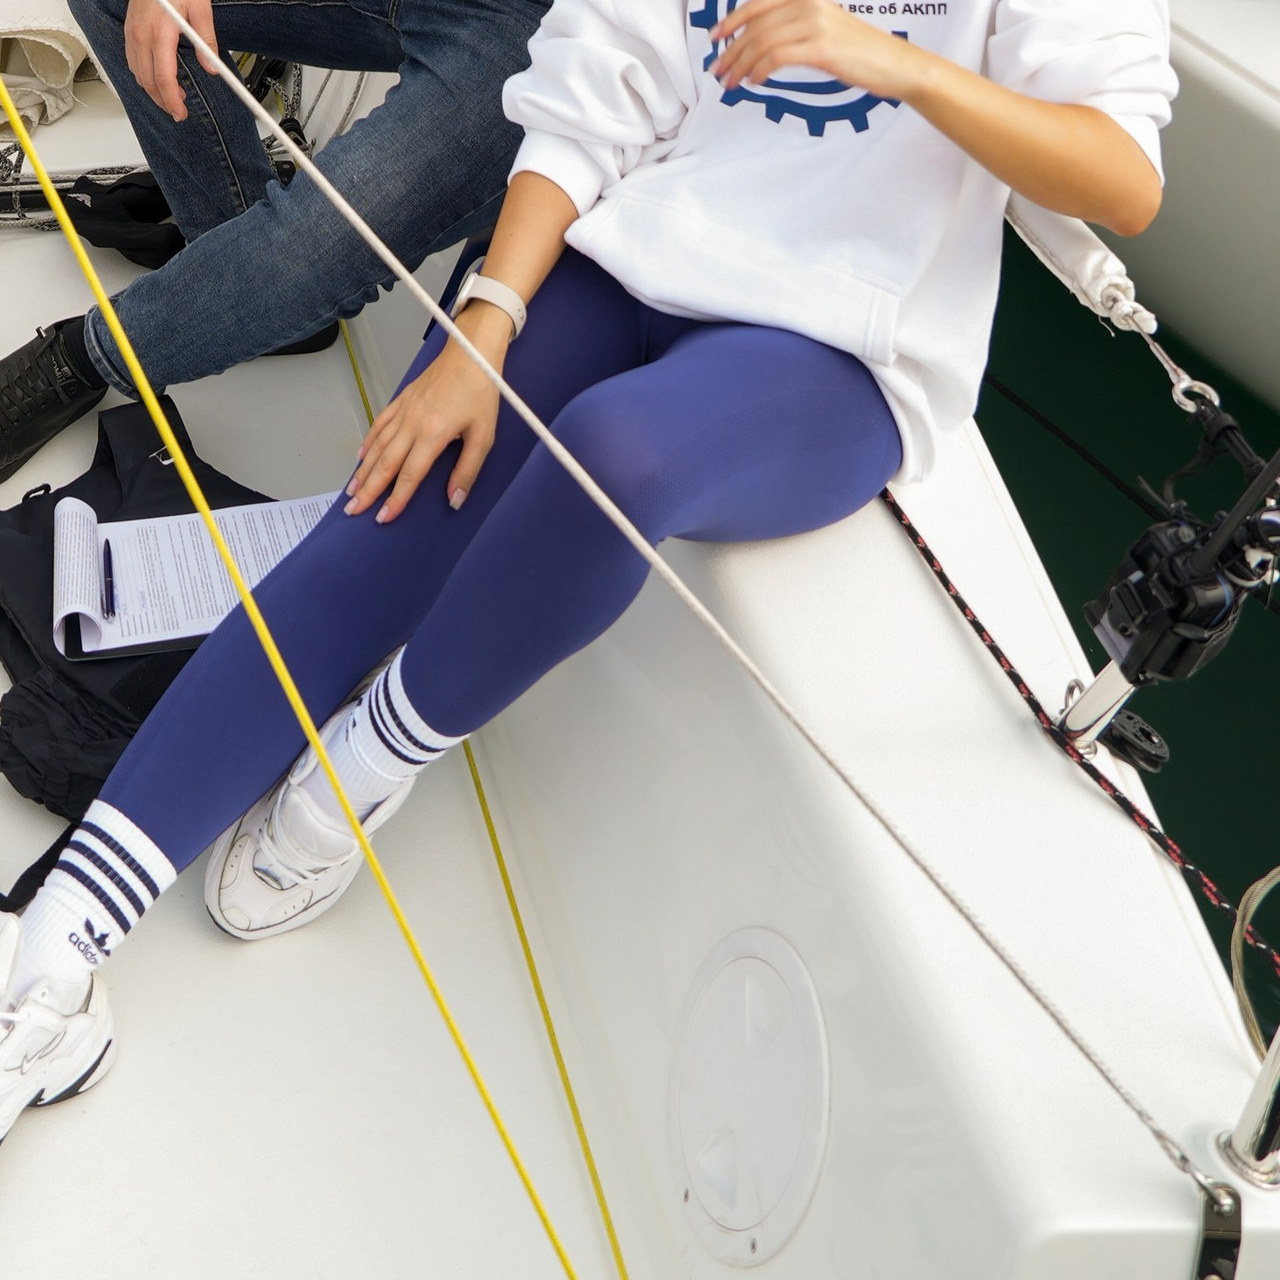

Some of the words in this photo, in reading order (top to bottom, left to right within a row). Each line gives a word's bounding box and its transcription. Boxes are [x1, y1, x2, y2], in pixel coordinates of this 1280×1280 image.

[849, 4, 874, 15] все
[879, 2, 897, 15] об
[902, 3, 947, 15] АКПП
